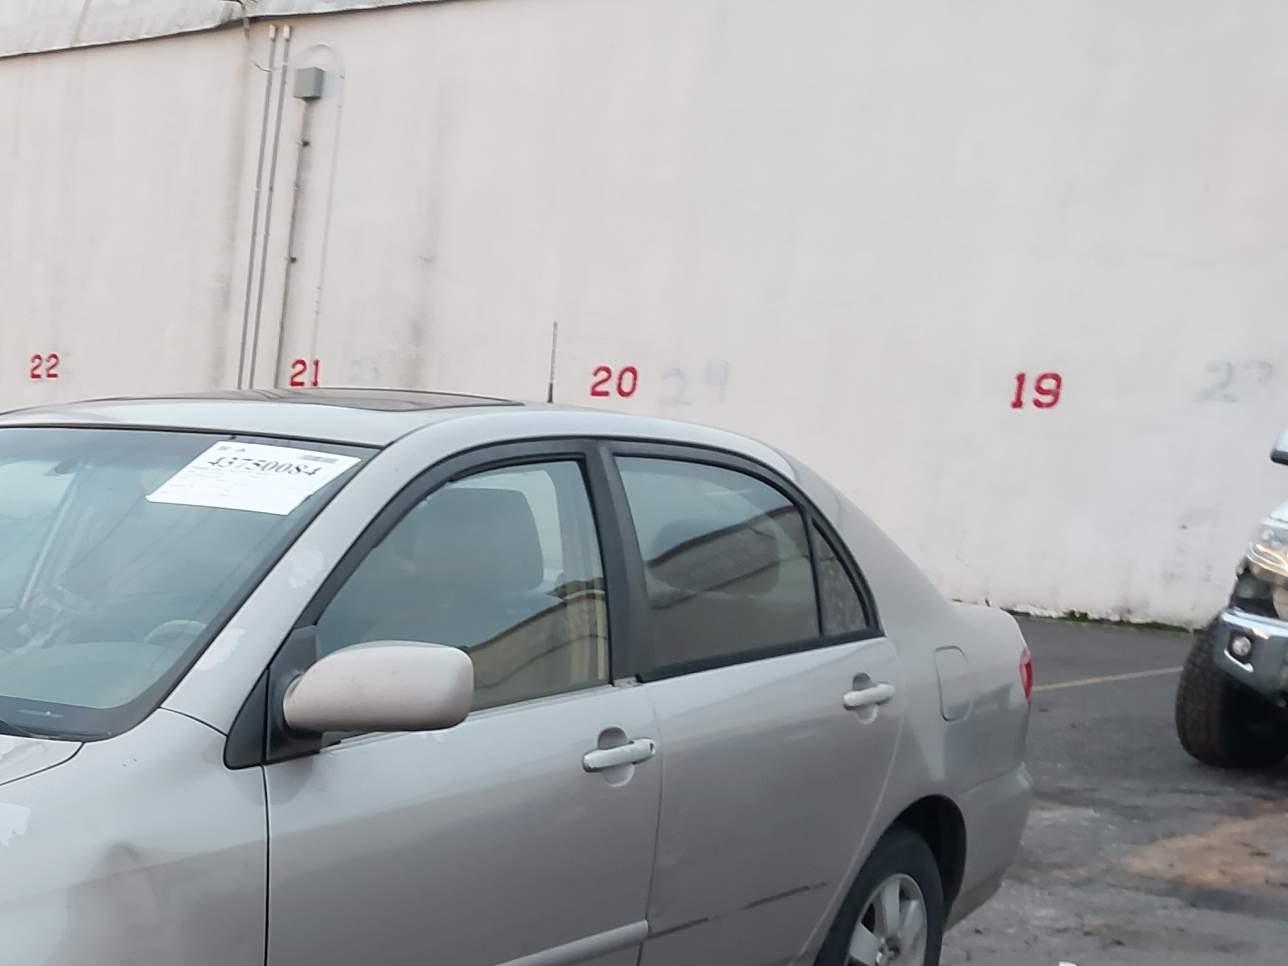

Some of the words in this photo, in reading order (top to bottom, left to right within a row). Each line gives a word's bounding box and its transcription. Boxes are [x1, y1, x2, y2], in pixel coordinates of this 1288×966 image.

[30, 353, 59, 379] 22
[289, 358, 320, 387] 21
[590, 365, 638, 398] 20
[1010, 372, 1062, 410] 19
